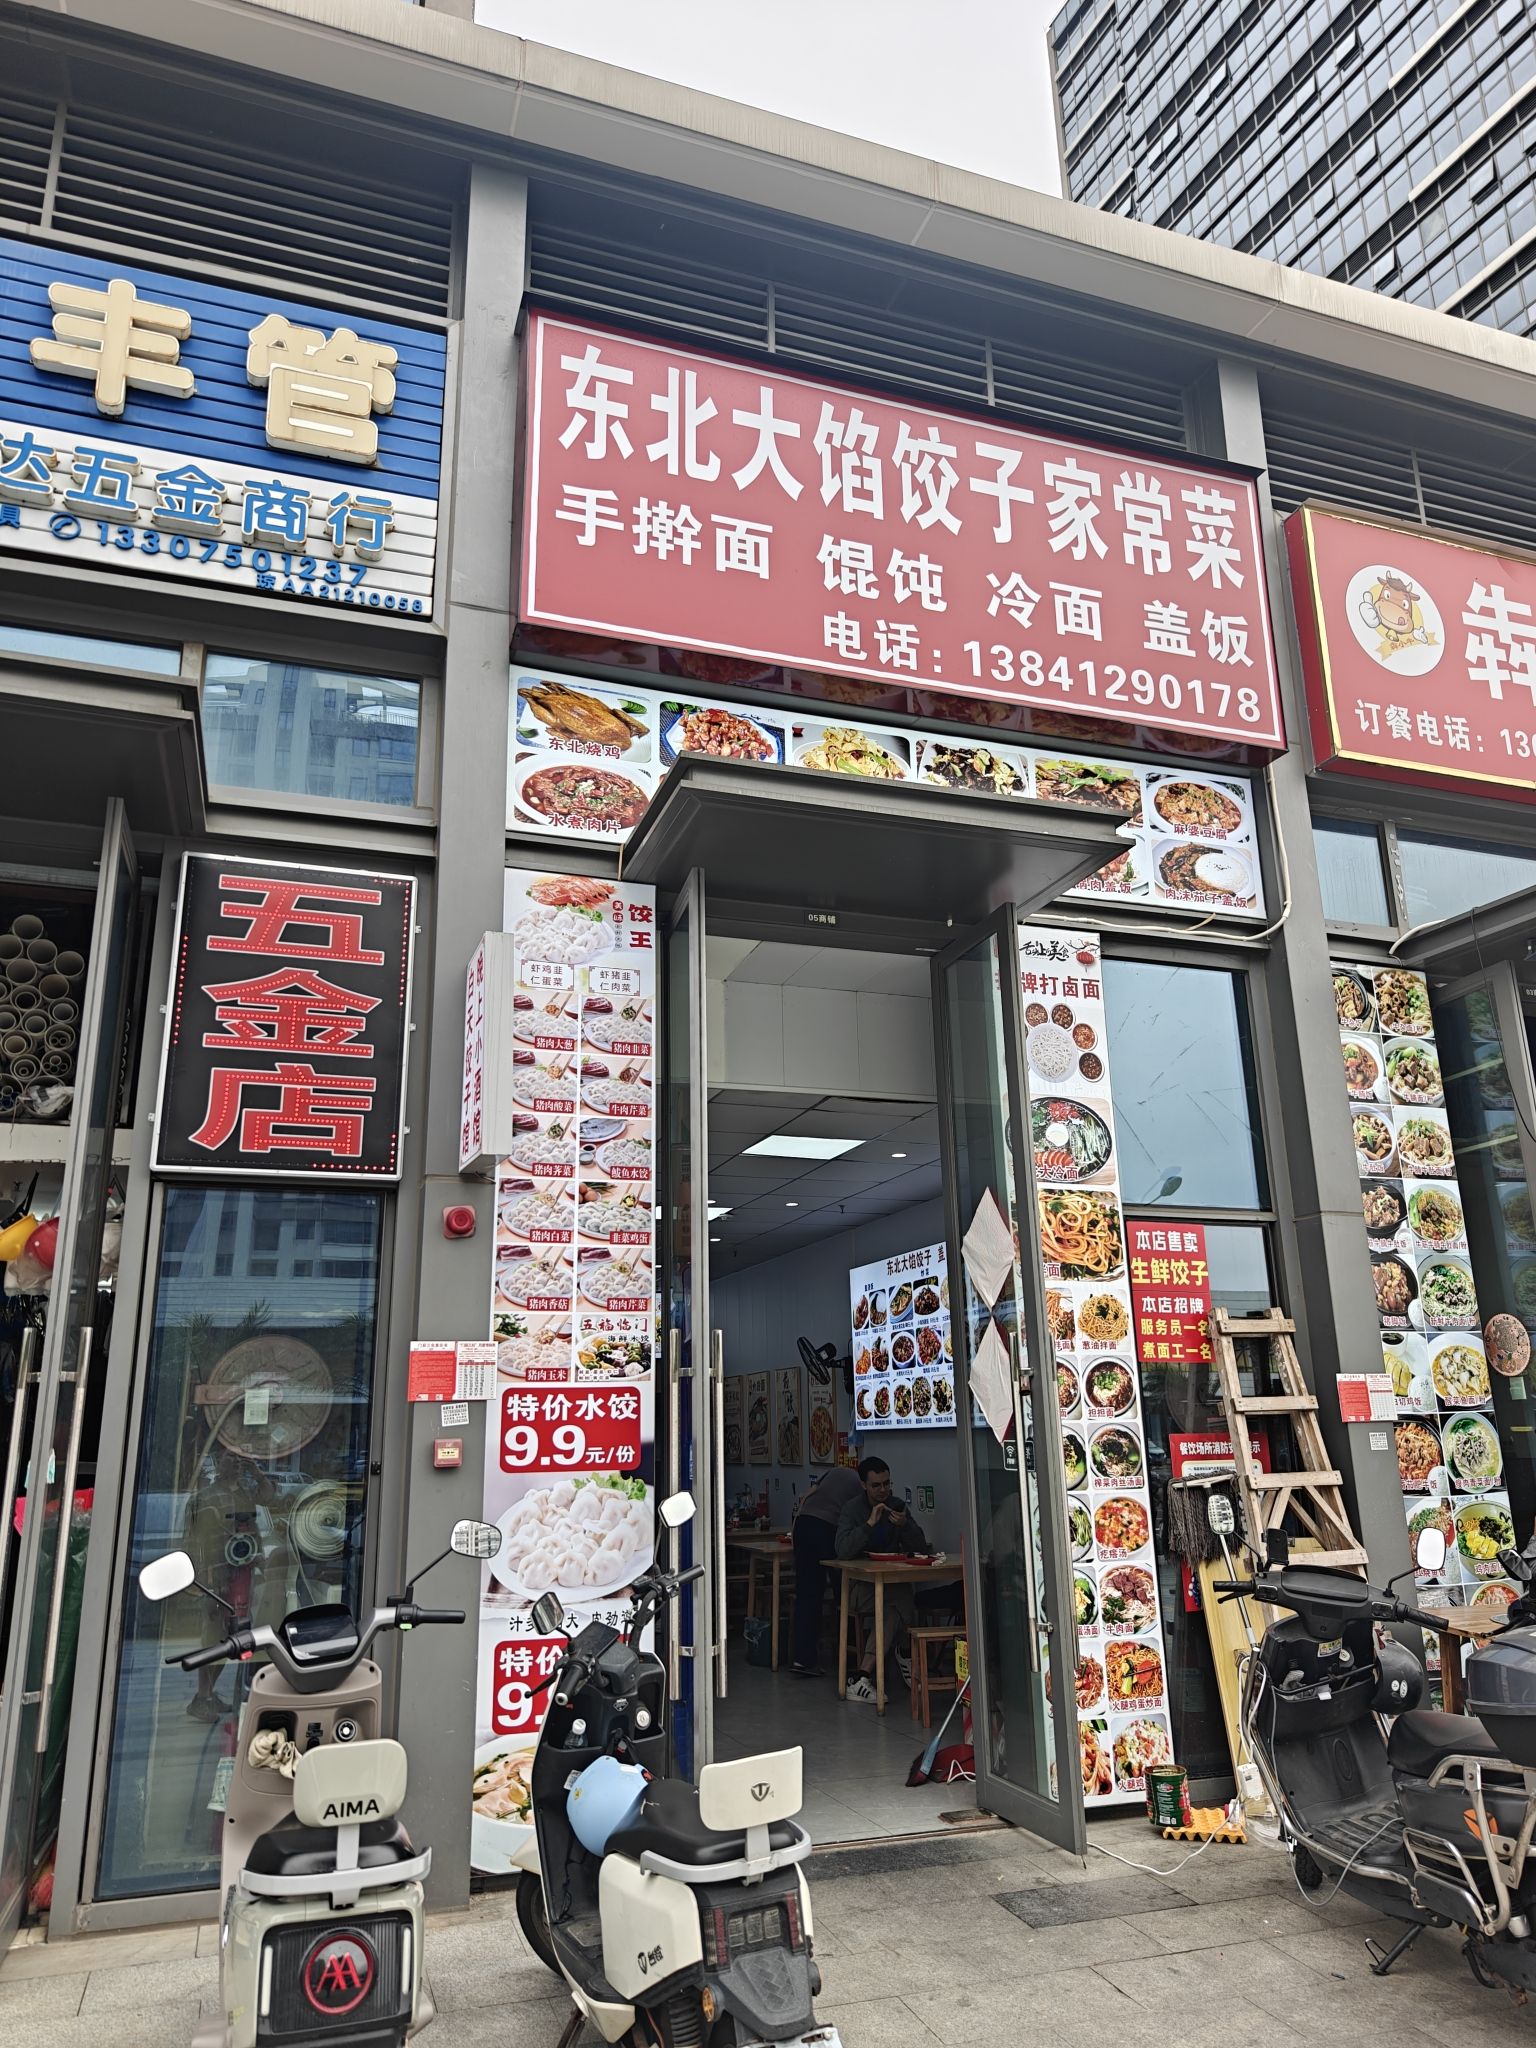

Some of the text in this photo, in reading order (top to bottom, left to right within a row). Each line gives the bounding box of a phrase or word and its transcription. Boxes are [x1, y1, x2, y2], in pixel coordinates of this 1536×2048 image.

[558, 344, 1245, 589] 东北大馅饺子家常菜
[97, 521, 369, 588] 13307501237
[555, 484, 1255, 668] 手擀面 馄饨 冷面 盖饭
[549, 737, 621, 759] 东北烧鸡
[549, 813, 621, 834] 水煮肉片
[1173, 822, 1228, 841] 麻婆豆腐
[1165, 888, 1248, 909] 肉沫茄子盖饭
[628, 903, 653, 949] 饺王
[188, 873, 385, 1157] 五金店
[536, 1036, 573, 1050] 猪肉大葱
[613, 1042, 649, 1055] 猪肉韭菜
[534, 1099, 573, 1113] 猪肉酸菜
[611, 1104, 647, 1117] 牛肉芹菜
[611, 1166, 648, 1179] 鲅鱼水饺
[531, 1230, 571, 1242] 猪肉白菜
[612, 1232, 648, 1245] 韭菜鸡蛋
[1136, 1230, 1198, 1253] 本店售卖
[886, 1249, 932, 1277] 东北大馅饺子
[1130, 1257, 1209, 1287] 生鲜饺子
[528, 1298, 568, 1311] 猪肉香菇
[608, 1299, 647, 1311] 猪肉芹菜
[1141, 1296, 1204, 1315] 本店招牌
[581, 1317, 648, 1333] 五福临门
[1140, 1318, 1208, 1337] 服务员一名
[607, 1334, 650, 1343] 海鲜水饺
[1082, 1339, 1117, 1351] 葱油拌面
[1142, 1341, 1212, 1360] 煮面工一名
[527, 1368, 567, 1381] 猪肉玉米
[507, 1393, 639, 1422] 特价水饺
[1088, 1408, 1115, 1418] 担担面
[1106, 1623, 1134, 1634] 牛肉面
[1112, 1698, 1163, 1711] 火腿鸡蛋炒面
[322, 1799, 380, 1819] AIMA
